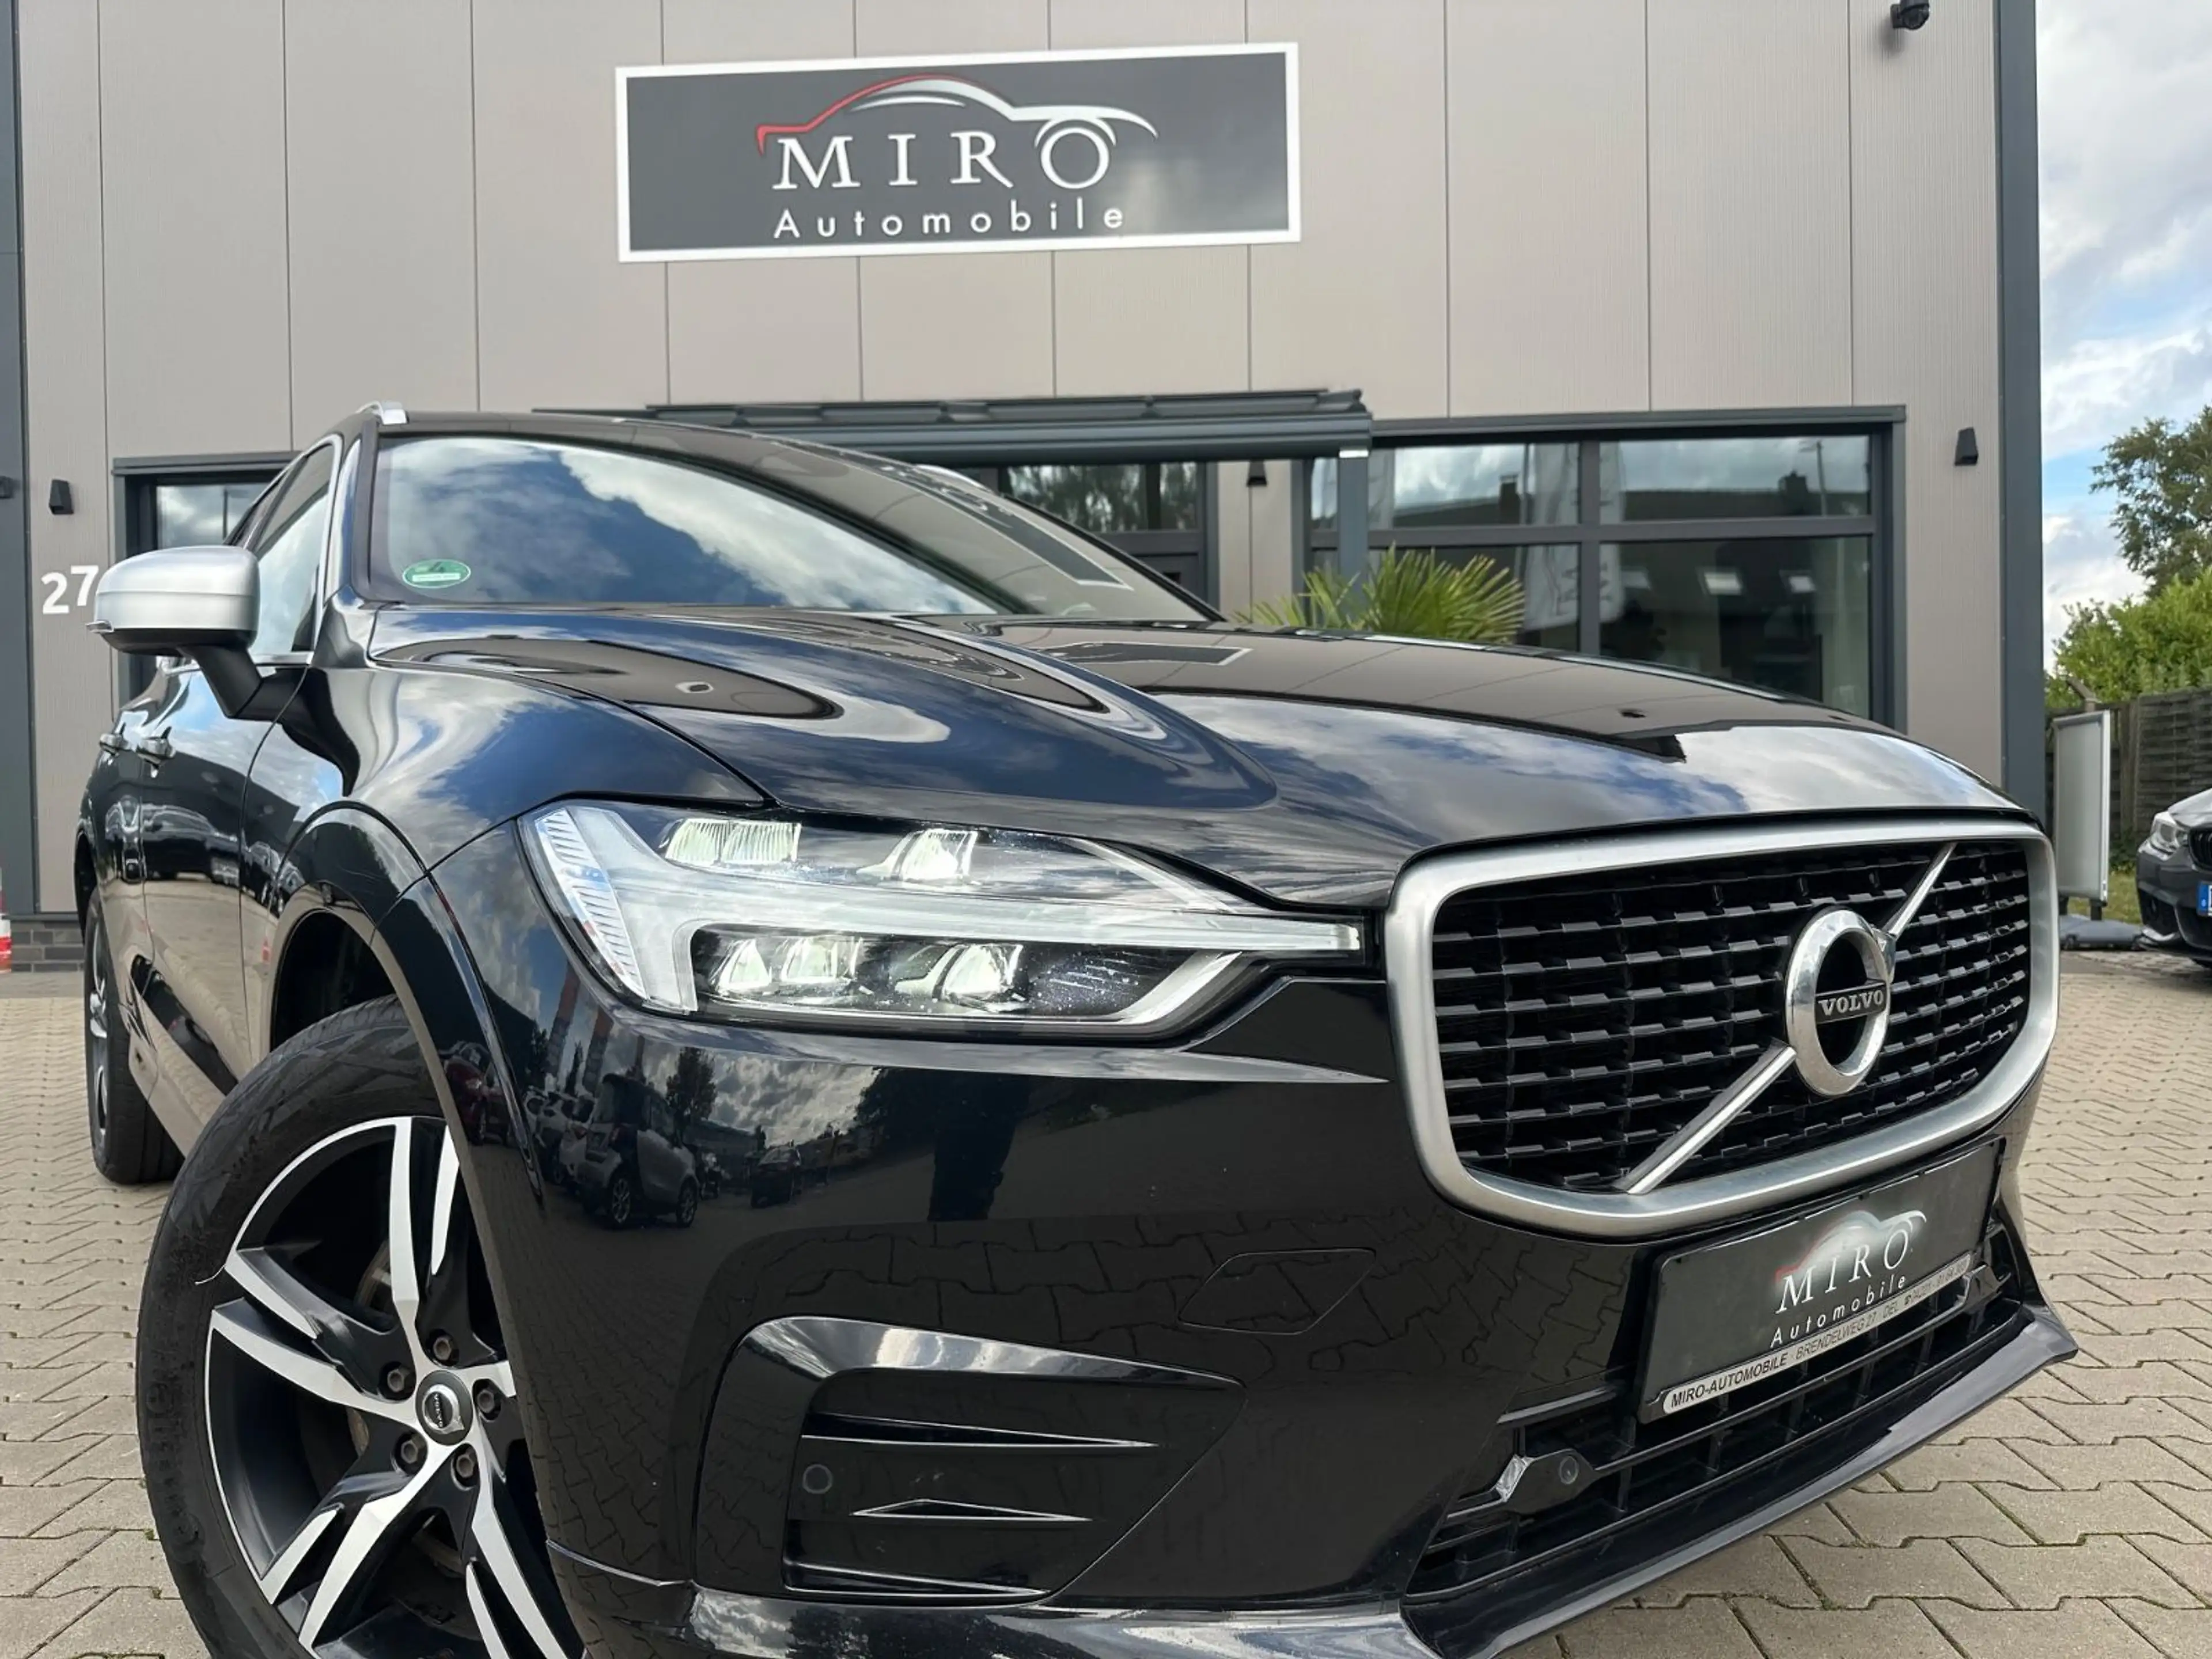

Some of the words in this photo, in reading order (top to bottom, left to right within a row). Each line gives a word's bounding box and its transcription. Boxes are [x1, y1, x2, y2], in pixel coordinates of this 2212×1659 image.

[772, 127, 1111, 190] MIRO
[774, 196, 1124, 239] Automobile
[41, 565, 100, 615] 27
[1817, 989, 1884, 1017] VOLVO
[1775, 1229, 1908, 1315] MIRO
[1770, 1274, 1906, 1349] Automobile
[1671, 1351, 1788, 1408] MIRO-AUTOMOBILE
